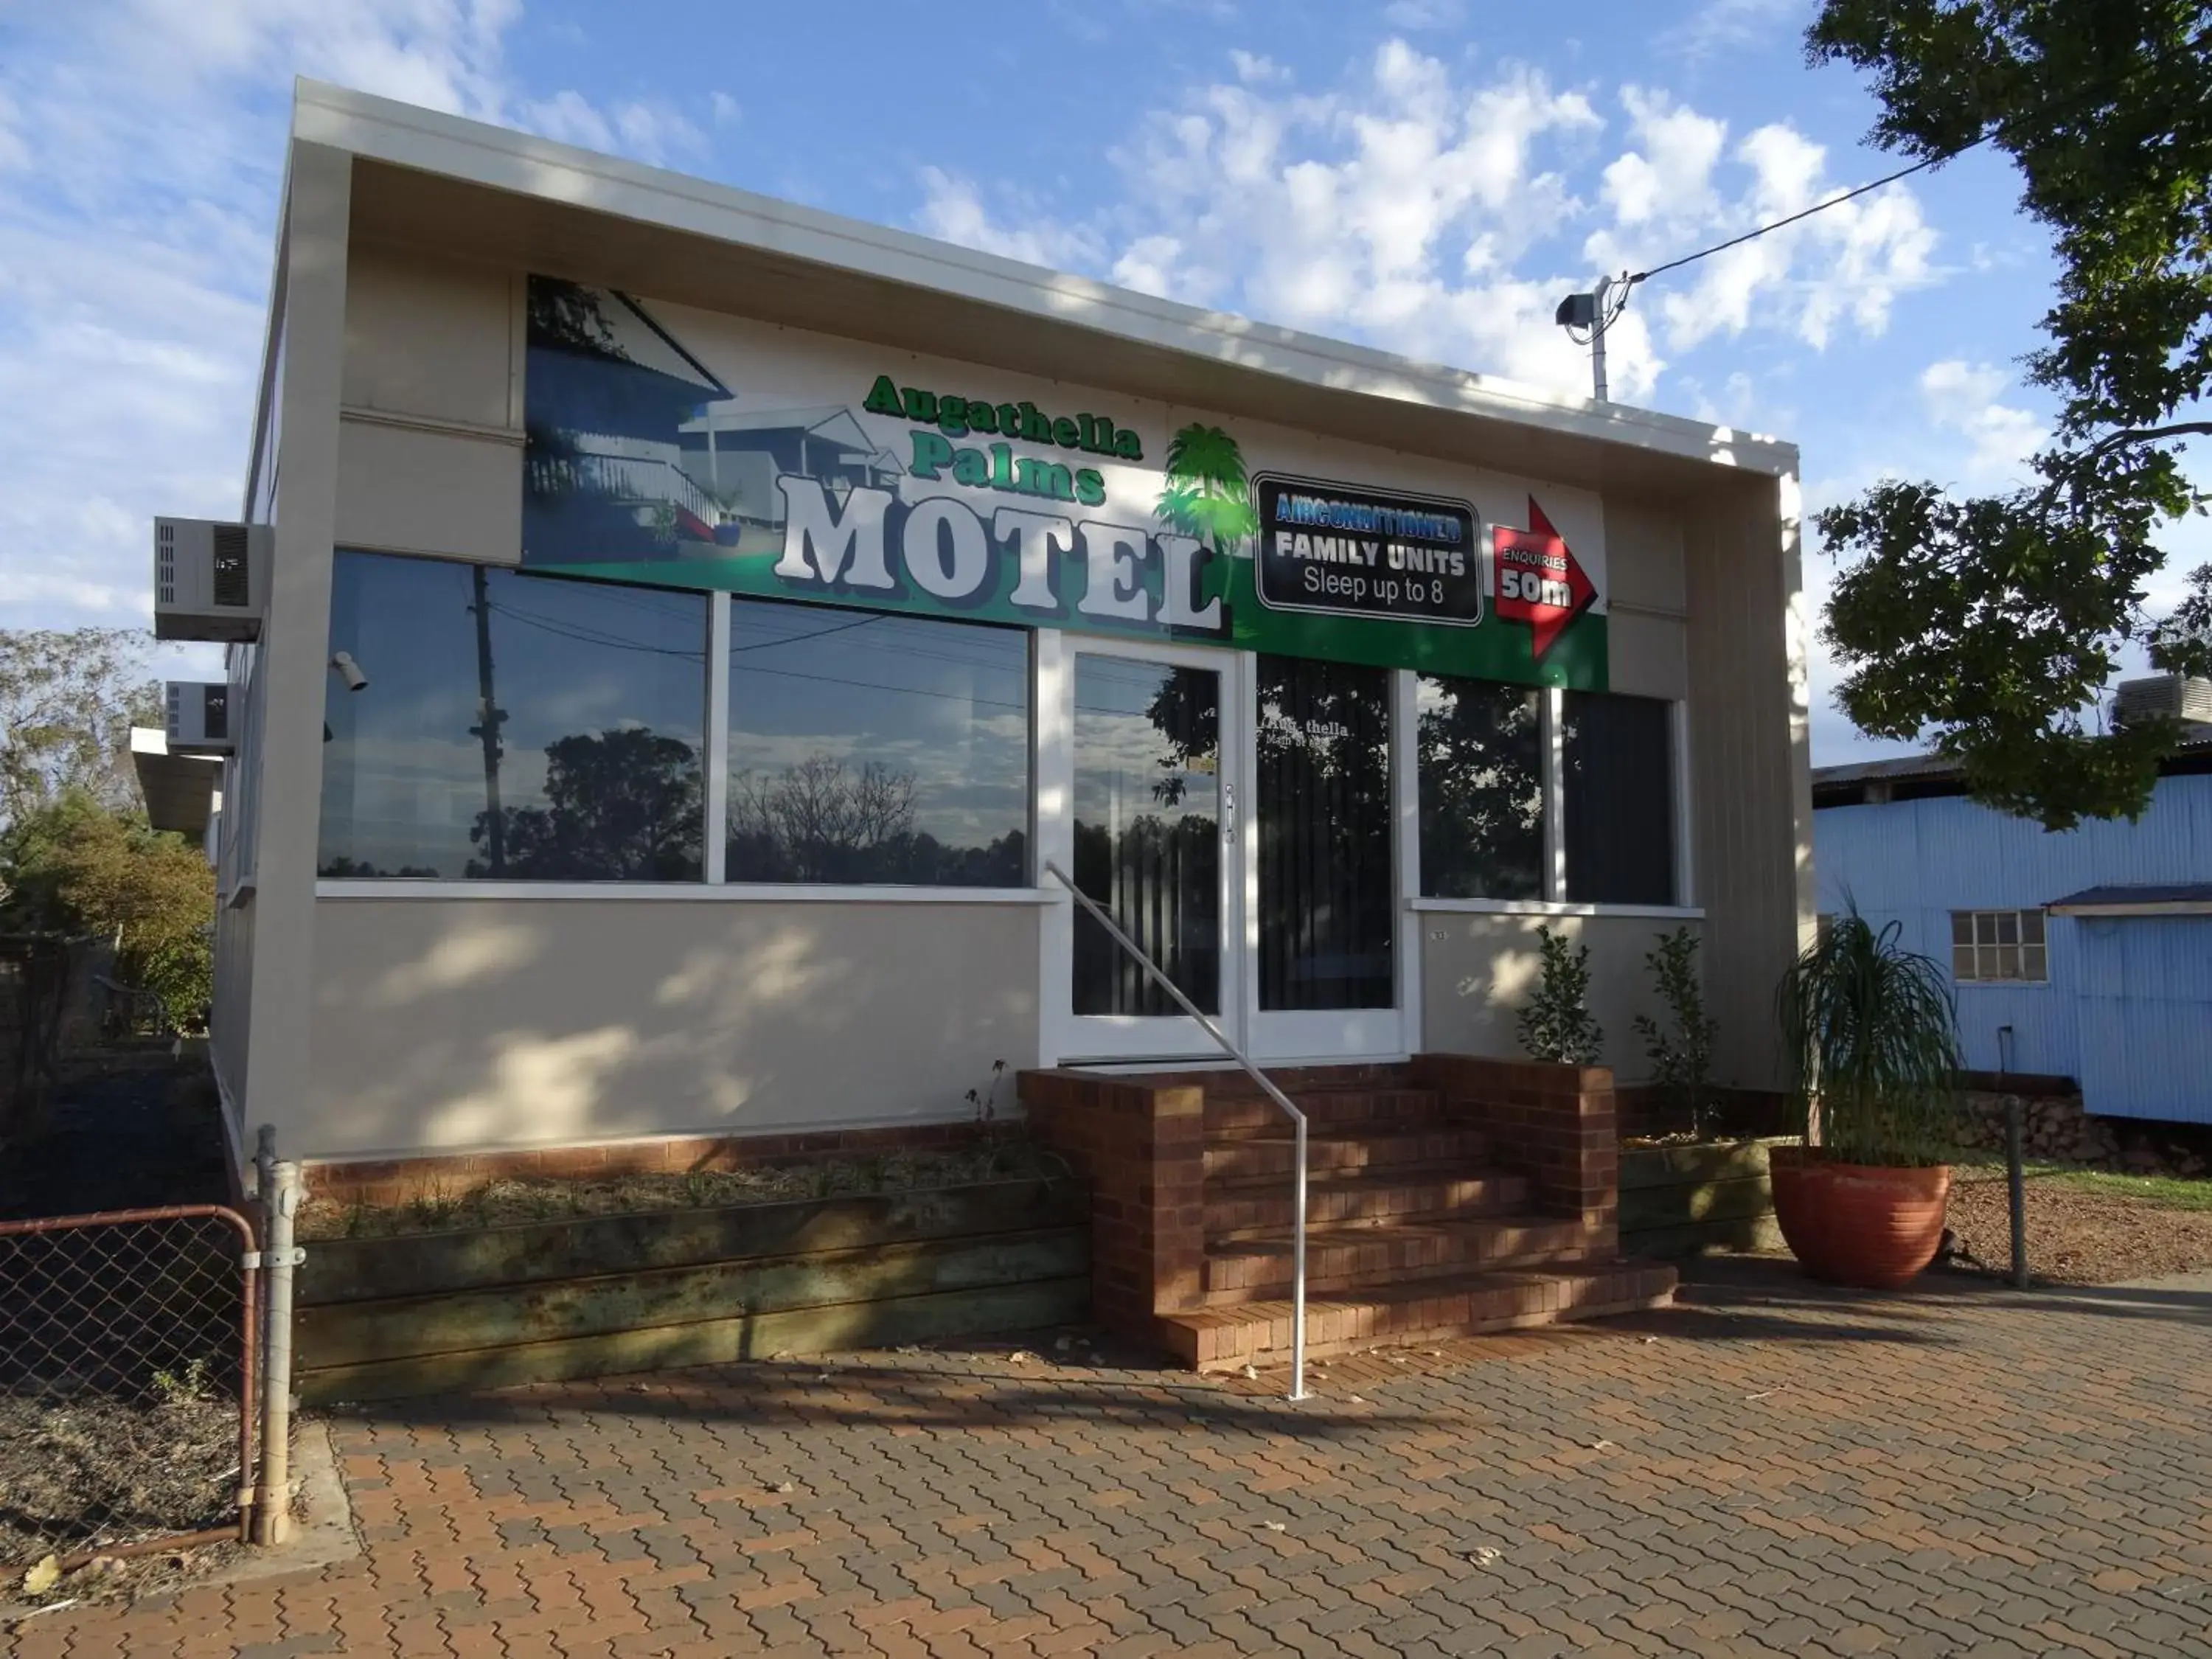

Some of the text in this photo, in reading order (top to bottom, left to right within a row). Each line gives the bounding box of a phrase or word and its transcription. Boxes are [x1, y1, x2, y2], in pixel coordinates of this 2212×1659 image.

[863, 375, 1144, 461] Augathella
[908, 430, 1106, 507] Palms
[1275, 493, 1462, 543] AIRCONDITIONED
[773, 473, 1228, 637] MOTEL
[1275, 530, 1465, 577] FAMILY UNITS
[1503, 547, 1568, 571] ENQUIRIES
[1304, 566, 1444, 605] Sleep up to 8
[1501, 568, 1571, 608] 50m
